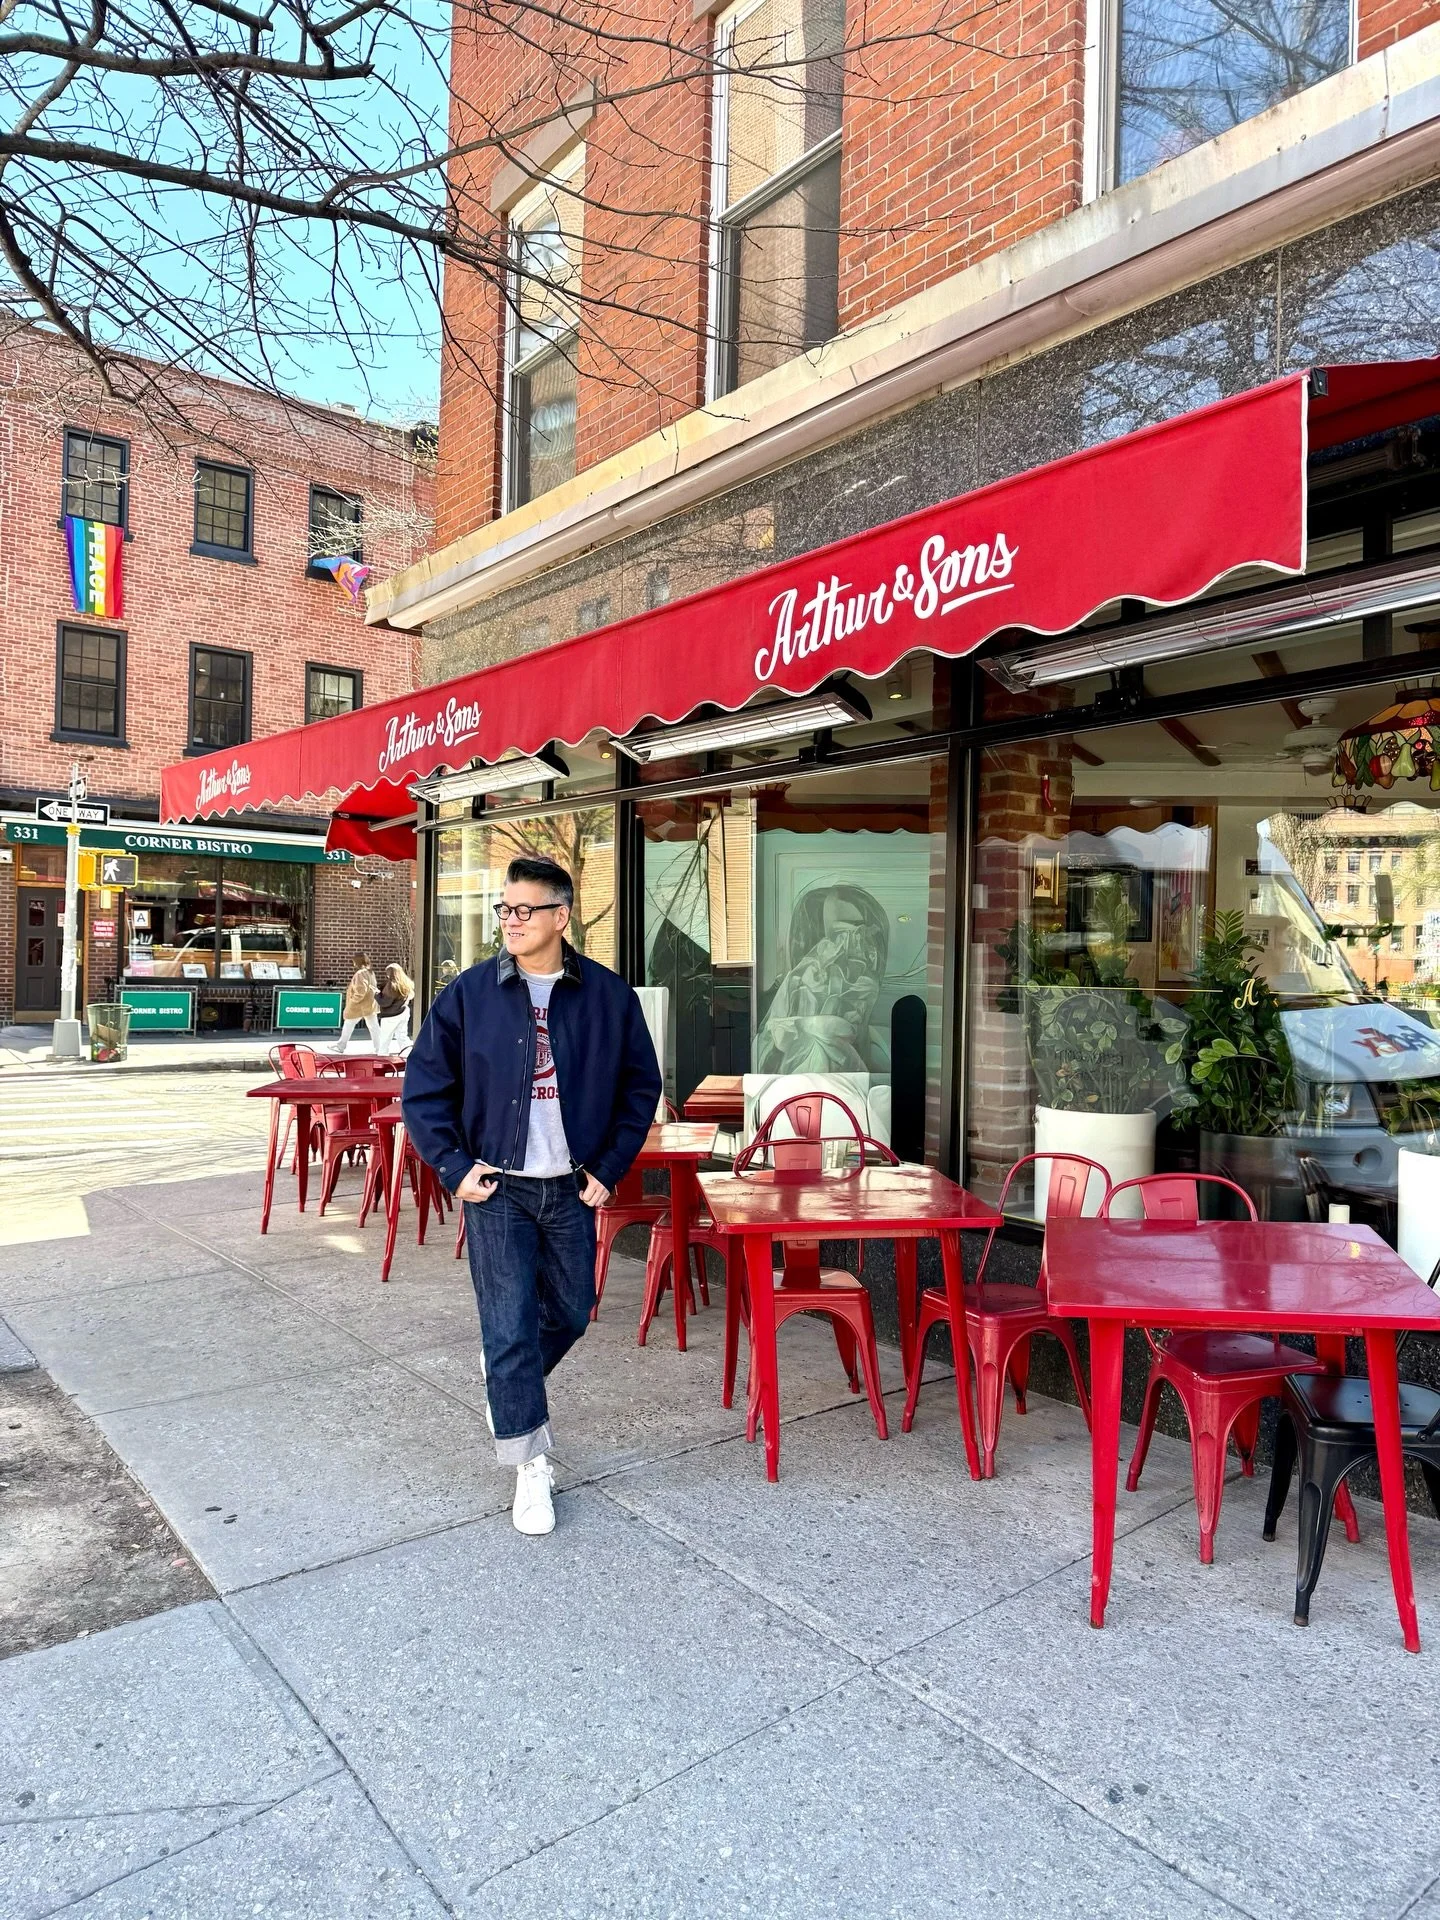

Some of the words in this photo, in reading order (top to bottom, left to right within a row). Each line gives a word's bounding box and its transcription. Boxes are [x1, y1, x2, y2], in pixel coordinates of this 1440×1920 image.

[88, 526, 106, 603] PEACE
[754, 575, 894, 681] Arthur
[892, 564, 915, 601] &
[913, 532, 1019, 619] Sons
[378, 711, 437, 773] Arthur
[435, 711, 445, 734] &
[443, 697, 482, 747] Sons
[195, 767, 228, 811] Arthur
[230, 759, 252, 796] Sons
[48, 806, 69, 817] ONE
[78, 809, 99, 819] WAY
[13, 826, 39, 840] 331
[124, 834, 193, 851] CORNER
[196, 840, 253, 855] BISTRO
[326, 850, 346, 861] 331
[136, 912, 146, 923] A
[1234, 979, 1259, 1010] A
[130, 1007, 157, 1015] CORNER
[158, 1007, 184, 1015] BISTRO
[285, 1006, 311, 1014] CORNER
